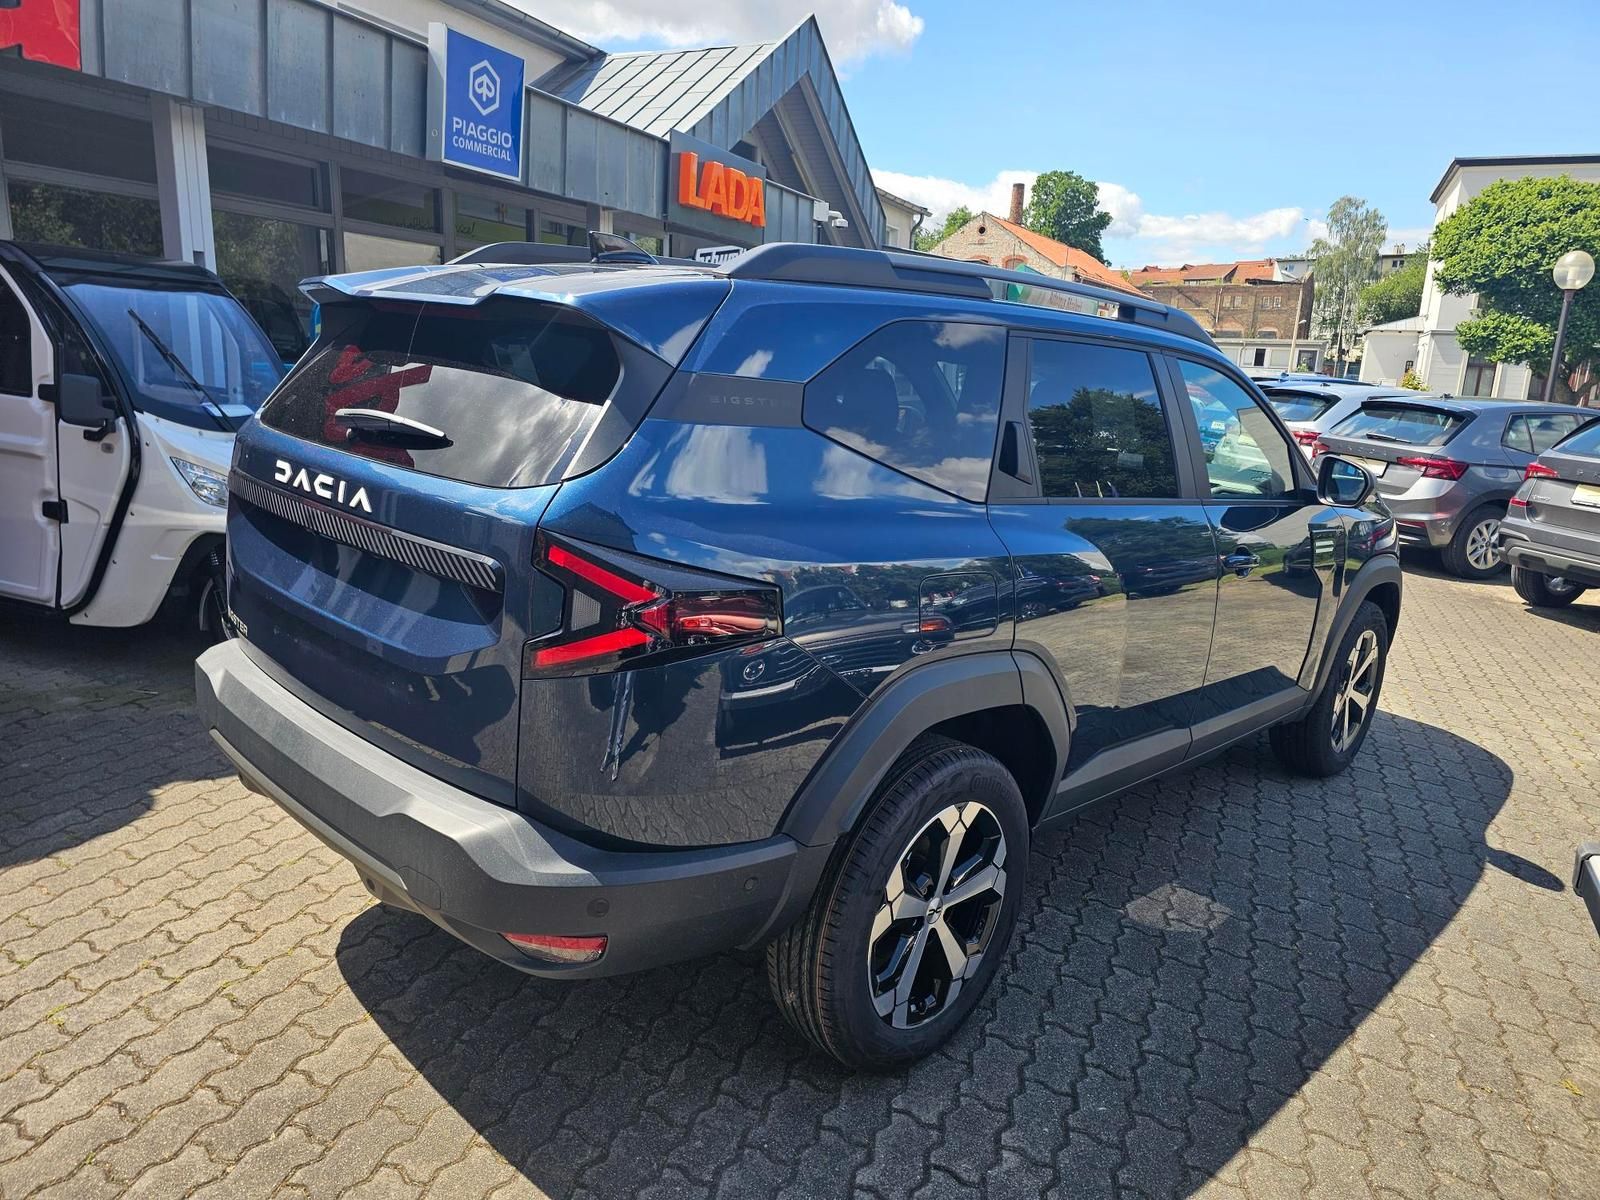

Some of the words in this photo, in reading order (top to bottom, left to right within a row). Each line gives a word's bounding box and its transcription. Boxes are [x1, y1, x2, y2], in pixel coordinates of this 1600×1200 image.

[452, 116, 512, 148] PIAGGIO
[452, 135, 511, 161] COMMERCIAL
[679, 151, 766, 228] LADA
[274, 459, 373, 513] DACIA
